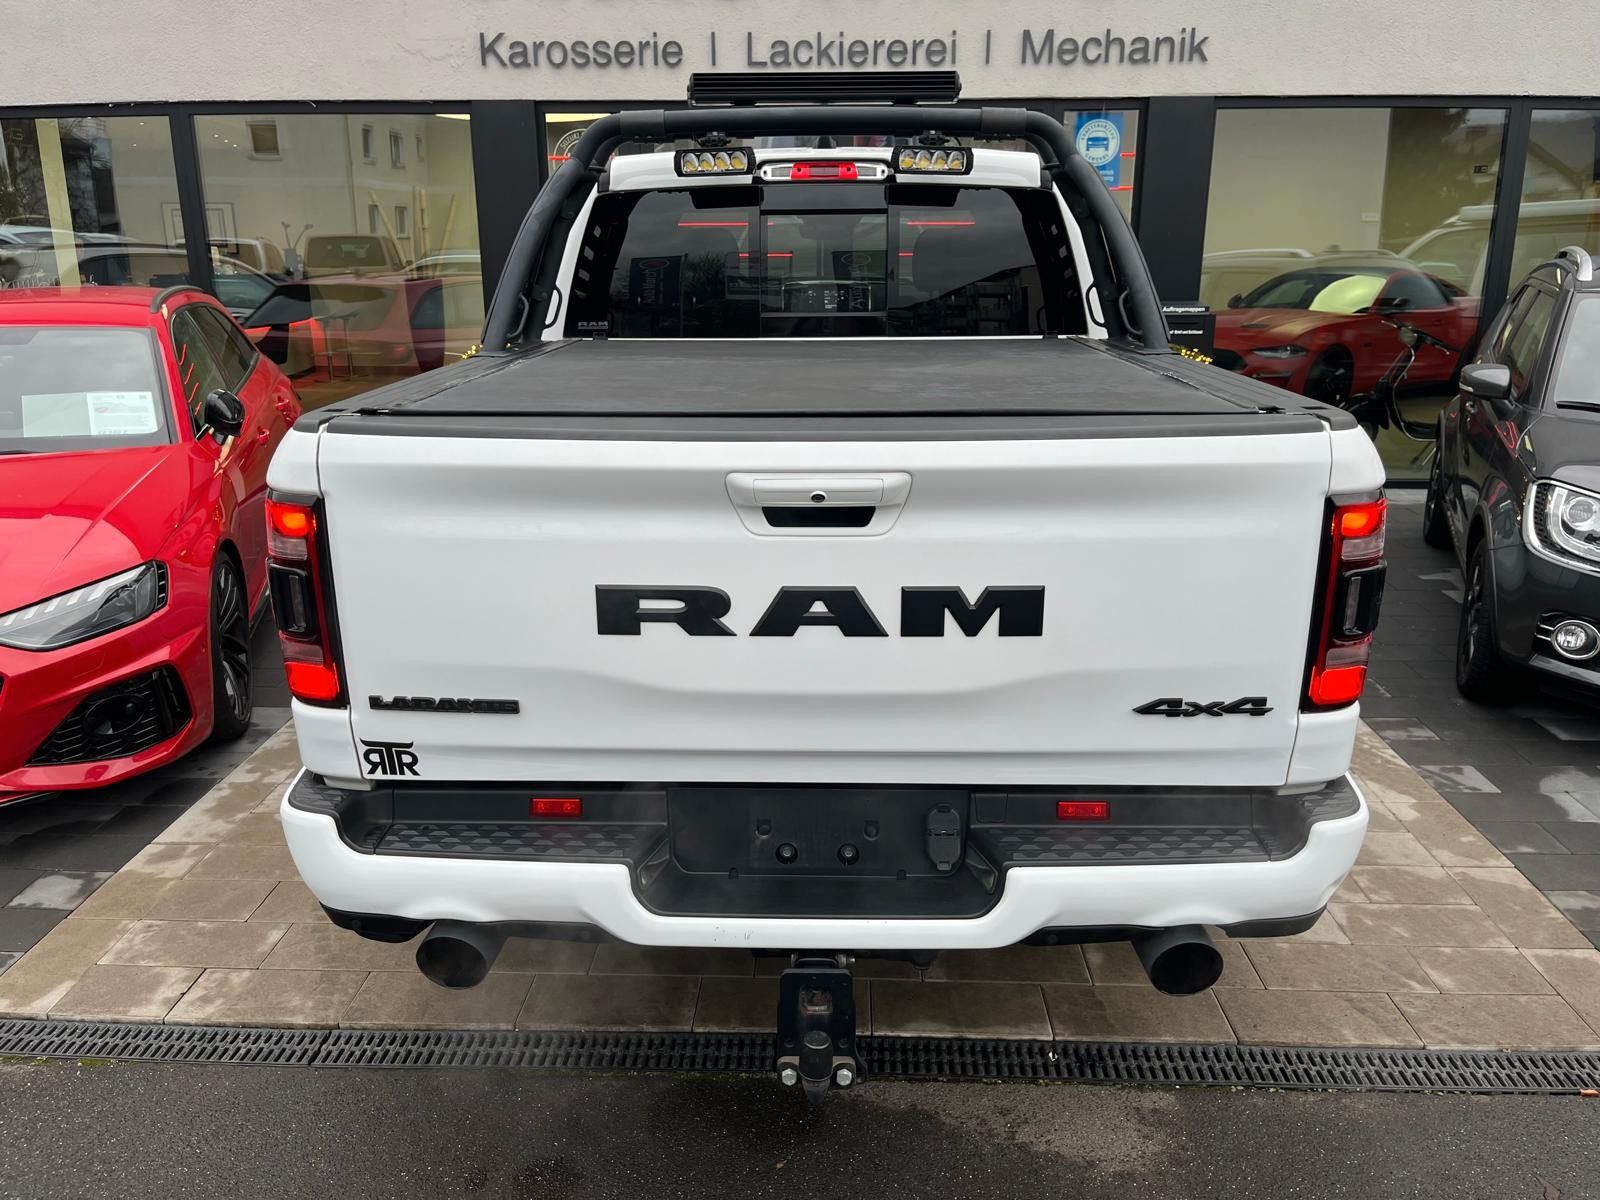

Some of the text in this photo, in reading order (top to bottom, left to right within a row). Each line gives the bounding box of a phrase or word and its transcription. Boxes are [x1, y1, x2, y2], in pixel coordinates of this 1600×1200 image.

[479, 31, 683, 69] Karosserie
[746, 30, 957, 68] Lackiererei
[1021, 27, 1209, 66] Mechanik
[595, 584, 1046, 637] RAM
[1132, 697, 1274, 717] 4x4
[360, 738, 421, 777] RTR
